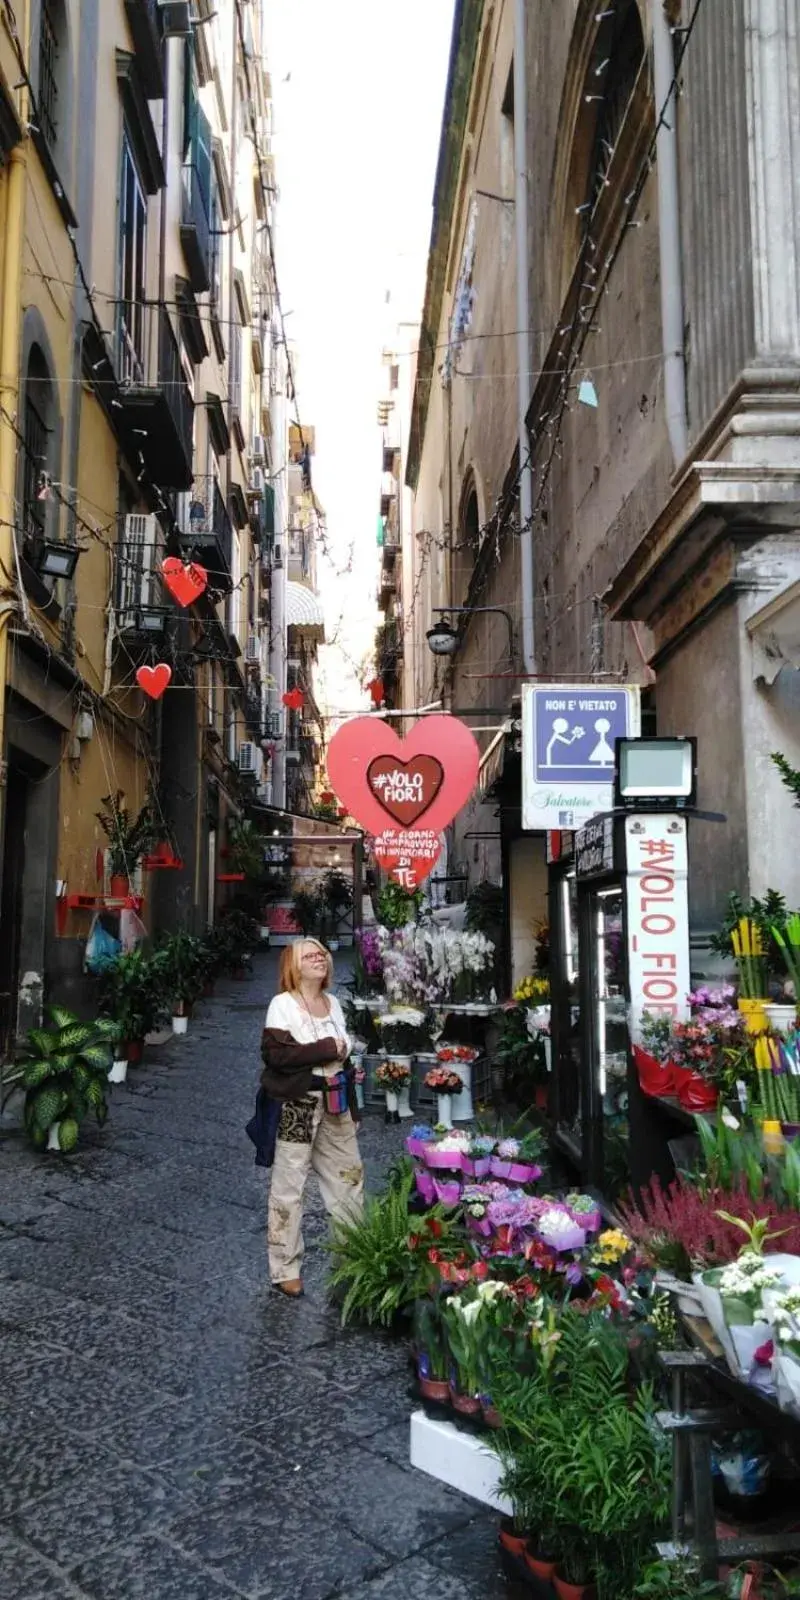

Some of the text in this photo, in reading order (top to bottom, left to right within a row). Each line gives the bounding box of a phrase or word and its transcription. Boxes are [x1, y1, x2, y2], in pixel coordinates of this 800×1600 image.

[545, 700, 566, 711] NON
[579, 700, 617, 711] VIETATO
[372, 769, 423, 788] #VOLO
[534, 791, 592, 807] Salvatore
[399, 857, 411, 866] DI
[393, 867, 417, 888] TE
